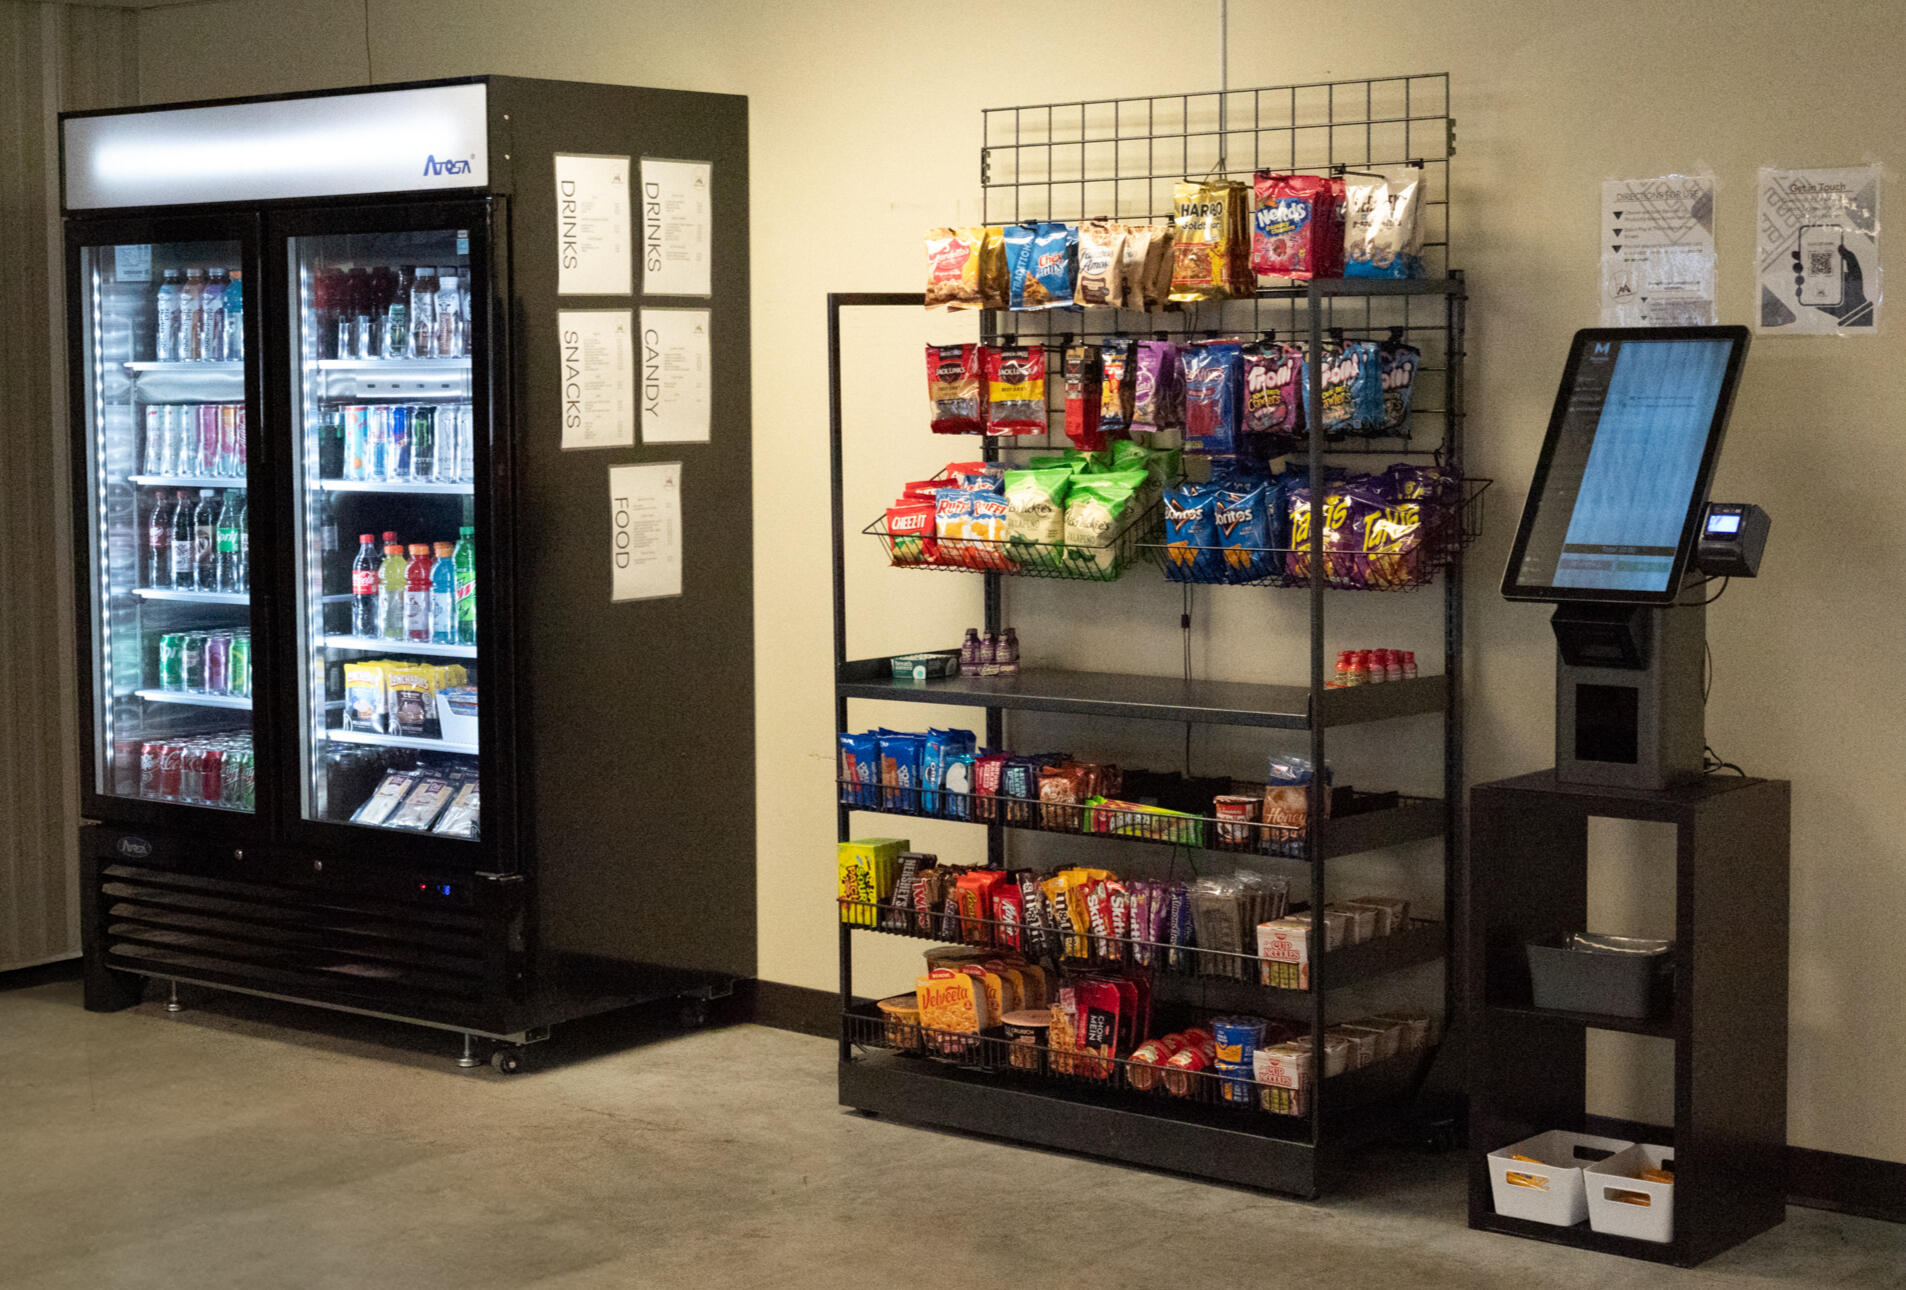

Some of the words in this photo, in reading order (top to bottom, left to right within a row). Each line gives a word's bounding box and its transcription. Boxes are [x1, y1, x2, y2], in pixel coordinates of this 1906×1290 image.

[1818, 182, 1846, 191] Touch
[561, 180, 578, 270] DRINKS
[645, 182, 662, 272] DRINKS
[1257, 200, 1306, 228] Nerds
[1080, 258, 1108, 271] Amos
[564, 330, 581, 429] SNACKS
[644, 329, 660, 417] CANDY
[1248, 359, 1293, 392] Trolli
[1382, 362, 1412, 390] olli
[614, 497, 630, 569] FOOD
[1290, 495, 1352, 550] Tais
[1265, 806, 1305, 825] Honey
[896, 859, 916, 907] HERSHEY'S
[922, 984, 968, 1010] Velveeta
[1089, 1015, 1097, 1041] MEIN
[1096, 1015, 1105, 1043] CHOW
